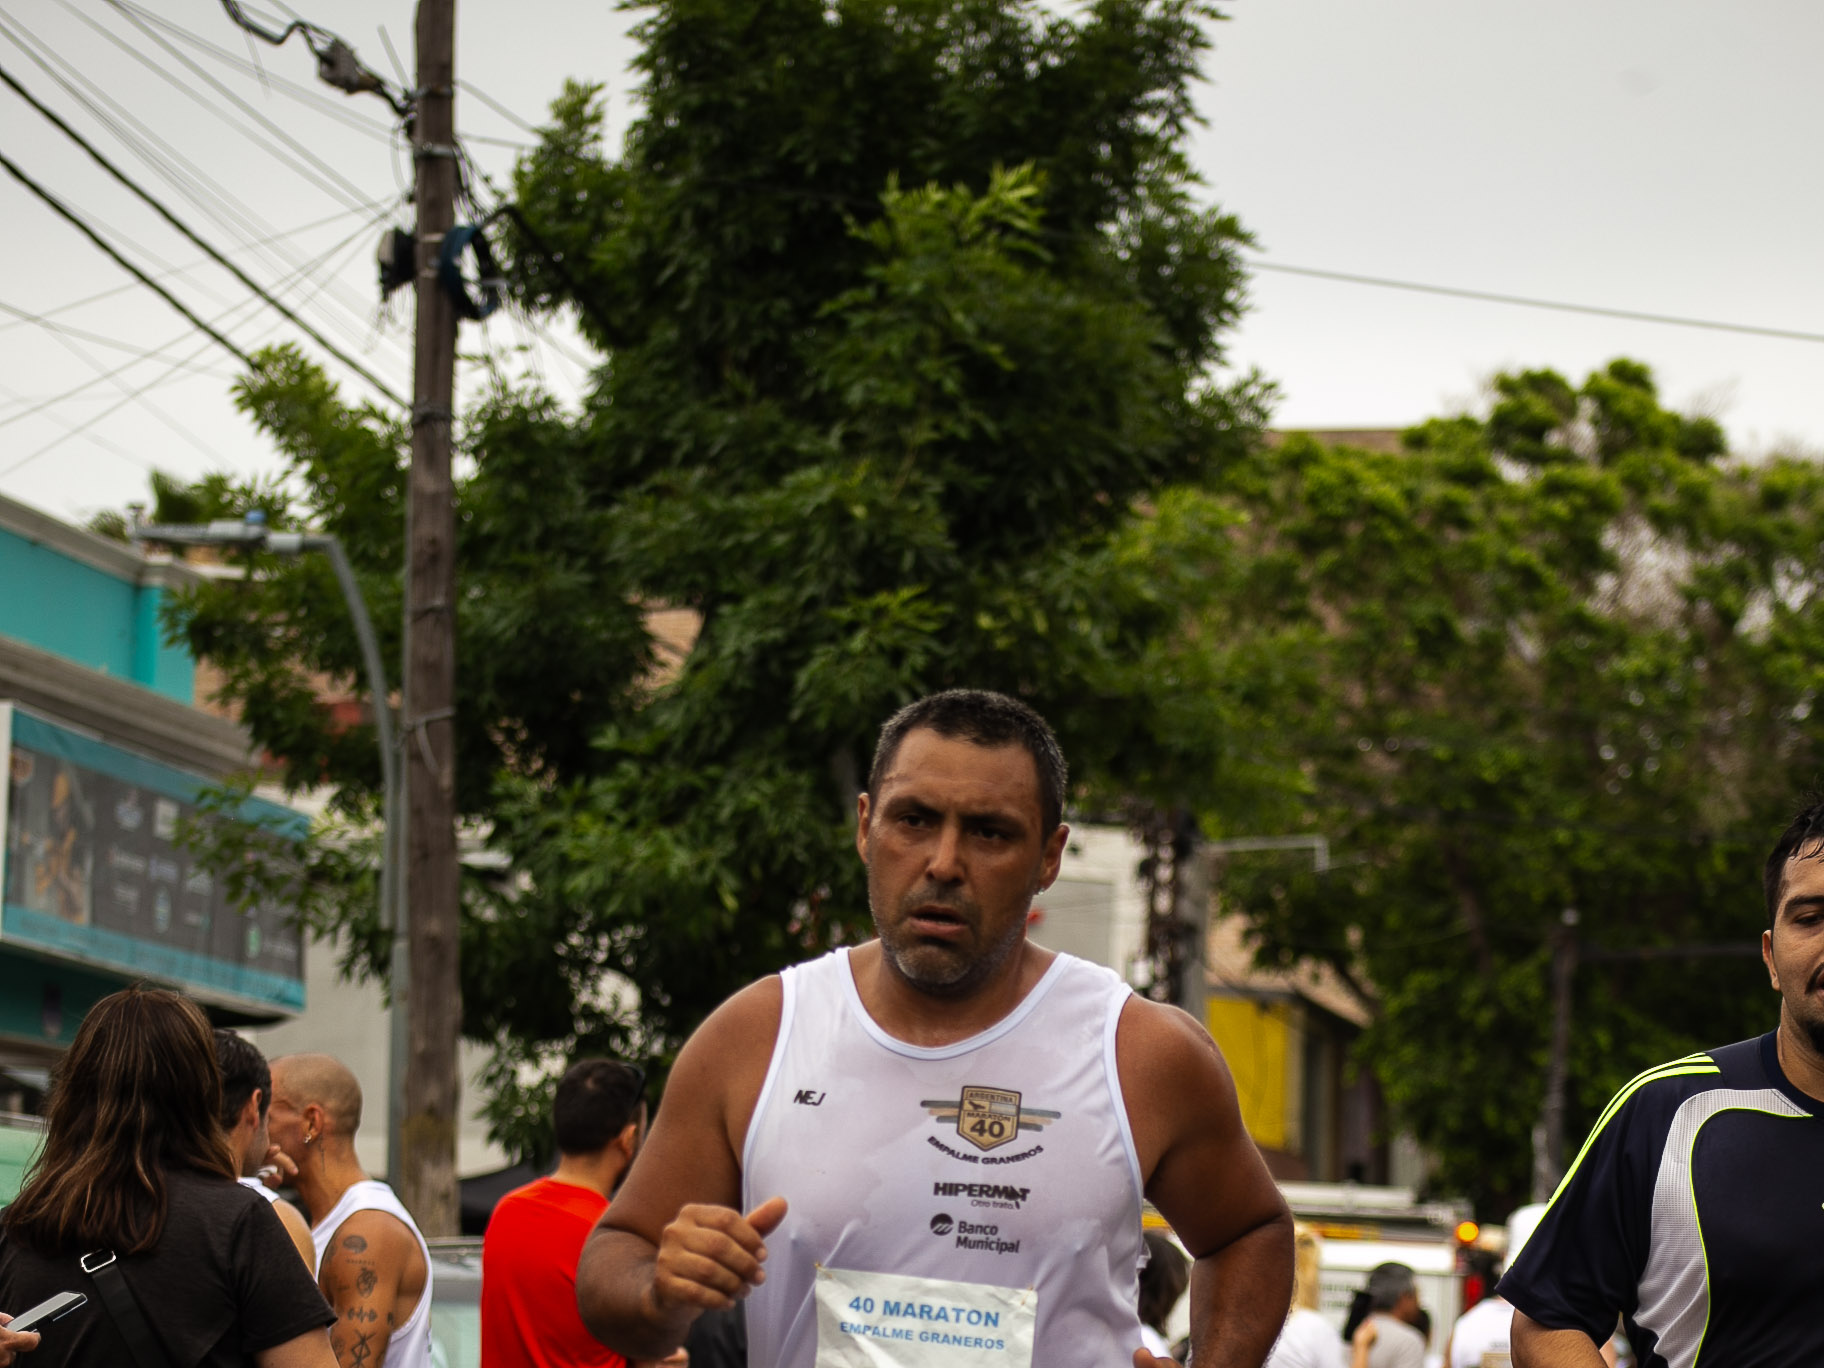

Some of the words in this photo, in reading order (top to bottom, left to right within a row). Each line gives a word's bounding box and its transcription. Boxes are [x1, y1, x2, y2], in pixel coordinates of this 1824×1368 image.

[793, 1089, 827, 1107] NEJ
[970, 1120, 1005, 1139] 40
[927, 1136, 979, 1164] EMPALME
[981, 1144, 1044, 1165] GRANEROS
[970, 1199, 991, 1208] Otro
[958, 1221, 998, 1236] Banco
[955, 1236, 1021, 1254] Municipal
[848, 1296, 875, 1314] 40
[883, 1300, 1000, 1328] MARATON
[839, 1321, 914, 1341] EMPALME
[919, 1331, 1005, 1350] GRANEROS
